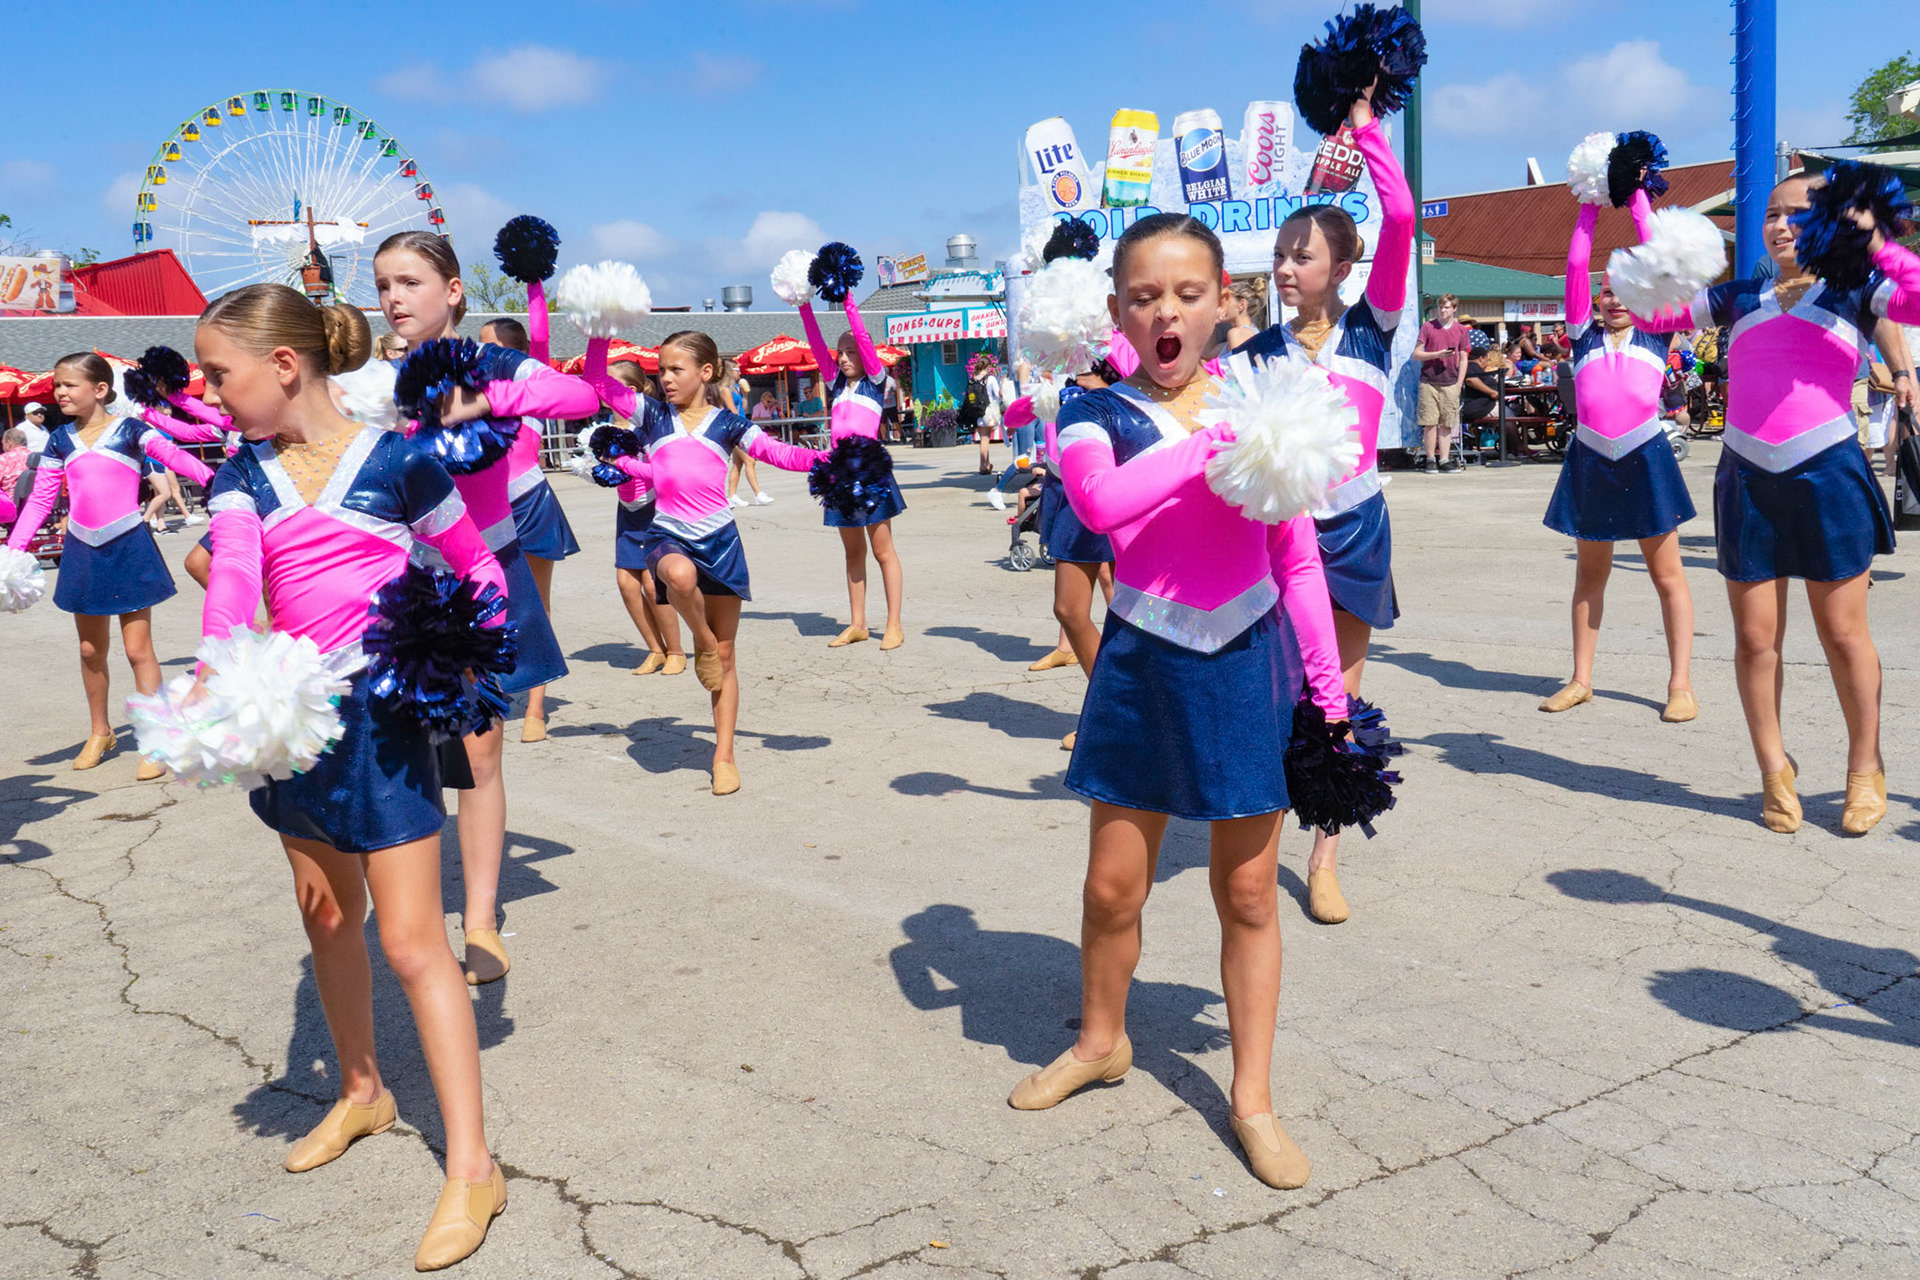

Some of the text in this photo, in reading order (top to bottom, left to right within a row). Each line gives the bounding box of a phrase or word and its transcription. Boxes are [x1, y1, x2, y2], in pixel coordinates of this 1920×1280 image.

[1035, 143, 1074, 175] Lite
[1180, 134, 1222, 167] BLUE MOON
[1249, 110, 1276, 186] Coors
[1273, 125, 1287, 172] LIGHT
[1185, 177, 1226, 191] BELGIAN
[1344, 166, 1360, 177] ALE
[1187, 186, 1228, 202] WHITE
[1052, 206, 1163, 241] OL
[889, 317, 961, 335] CONES CUPS
